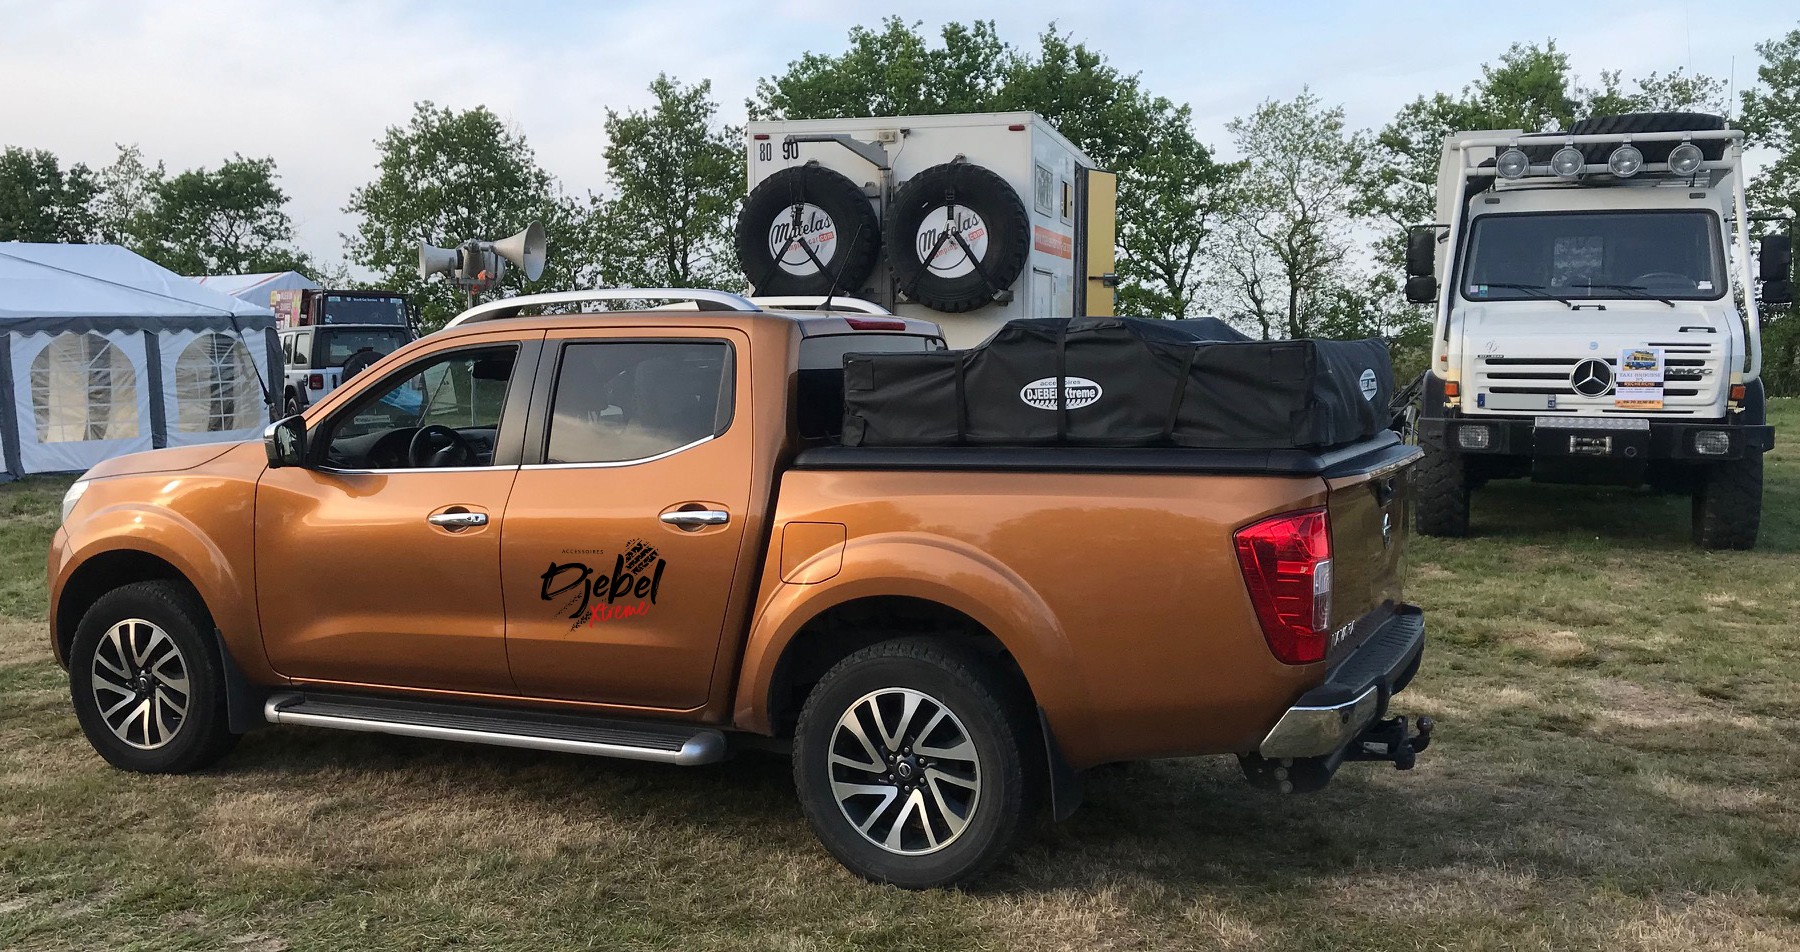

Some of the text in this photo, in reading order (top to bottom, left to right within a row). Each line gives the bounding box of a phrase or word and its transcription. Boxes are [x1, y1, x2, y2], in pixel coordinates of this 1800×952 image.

[760, 143, 771, 161] 80
[782, 141, 799, 160] 90
[771, 211, 832, 244] Matelas
[1664, 367, 1713, 376] NIMOG
[540, 553, 667, 619] Djebel
